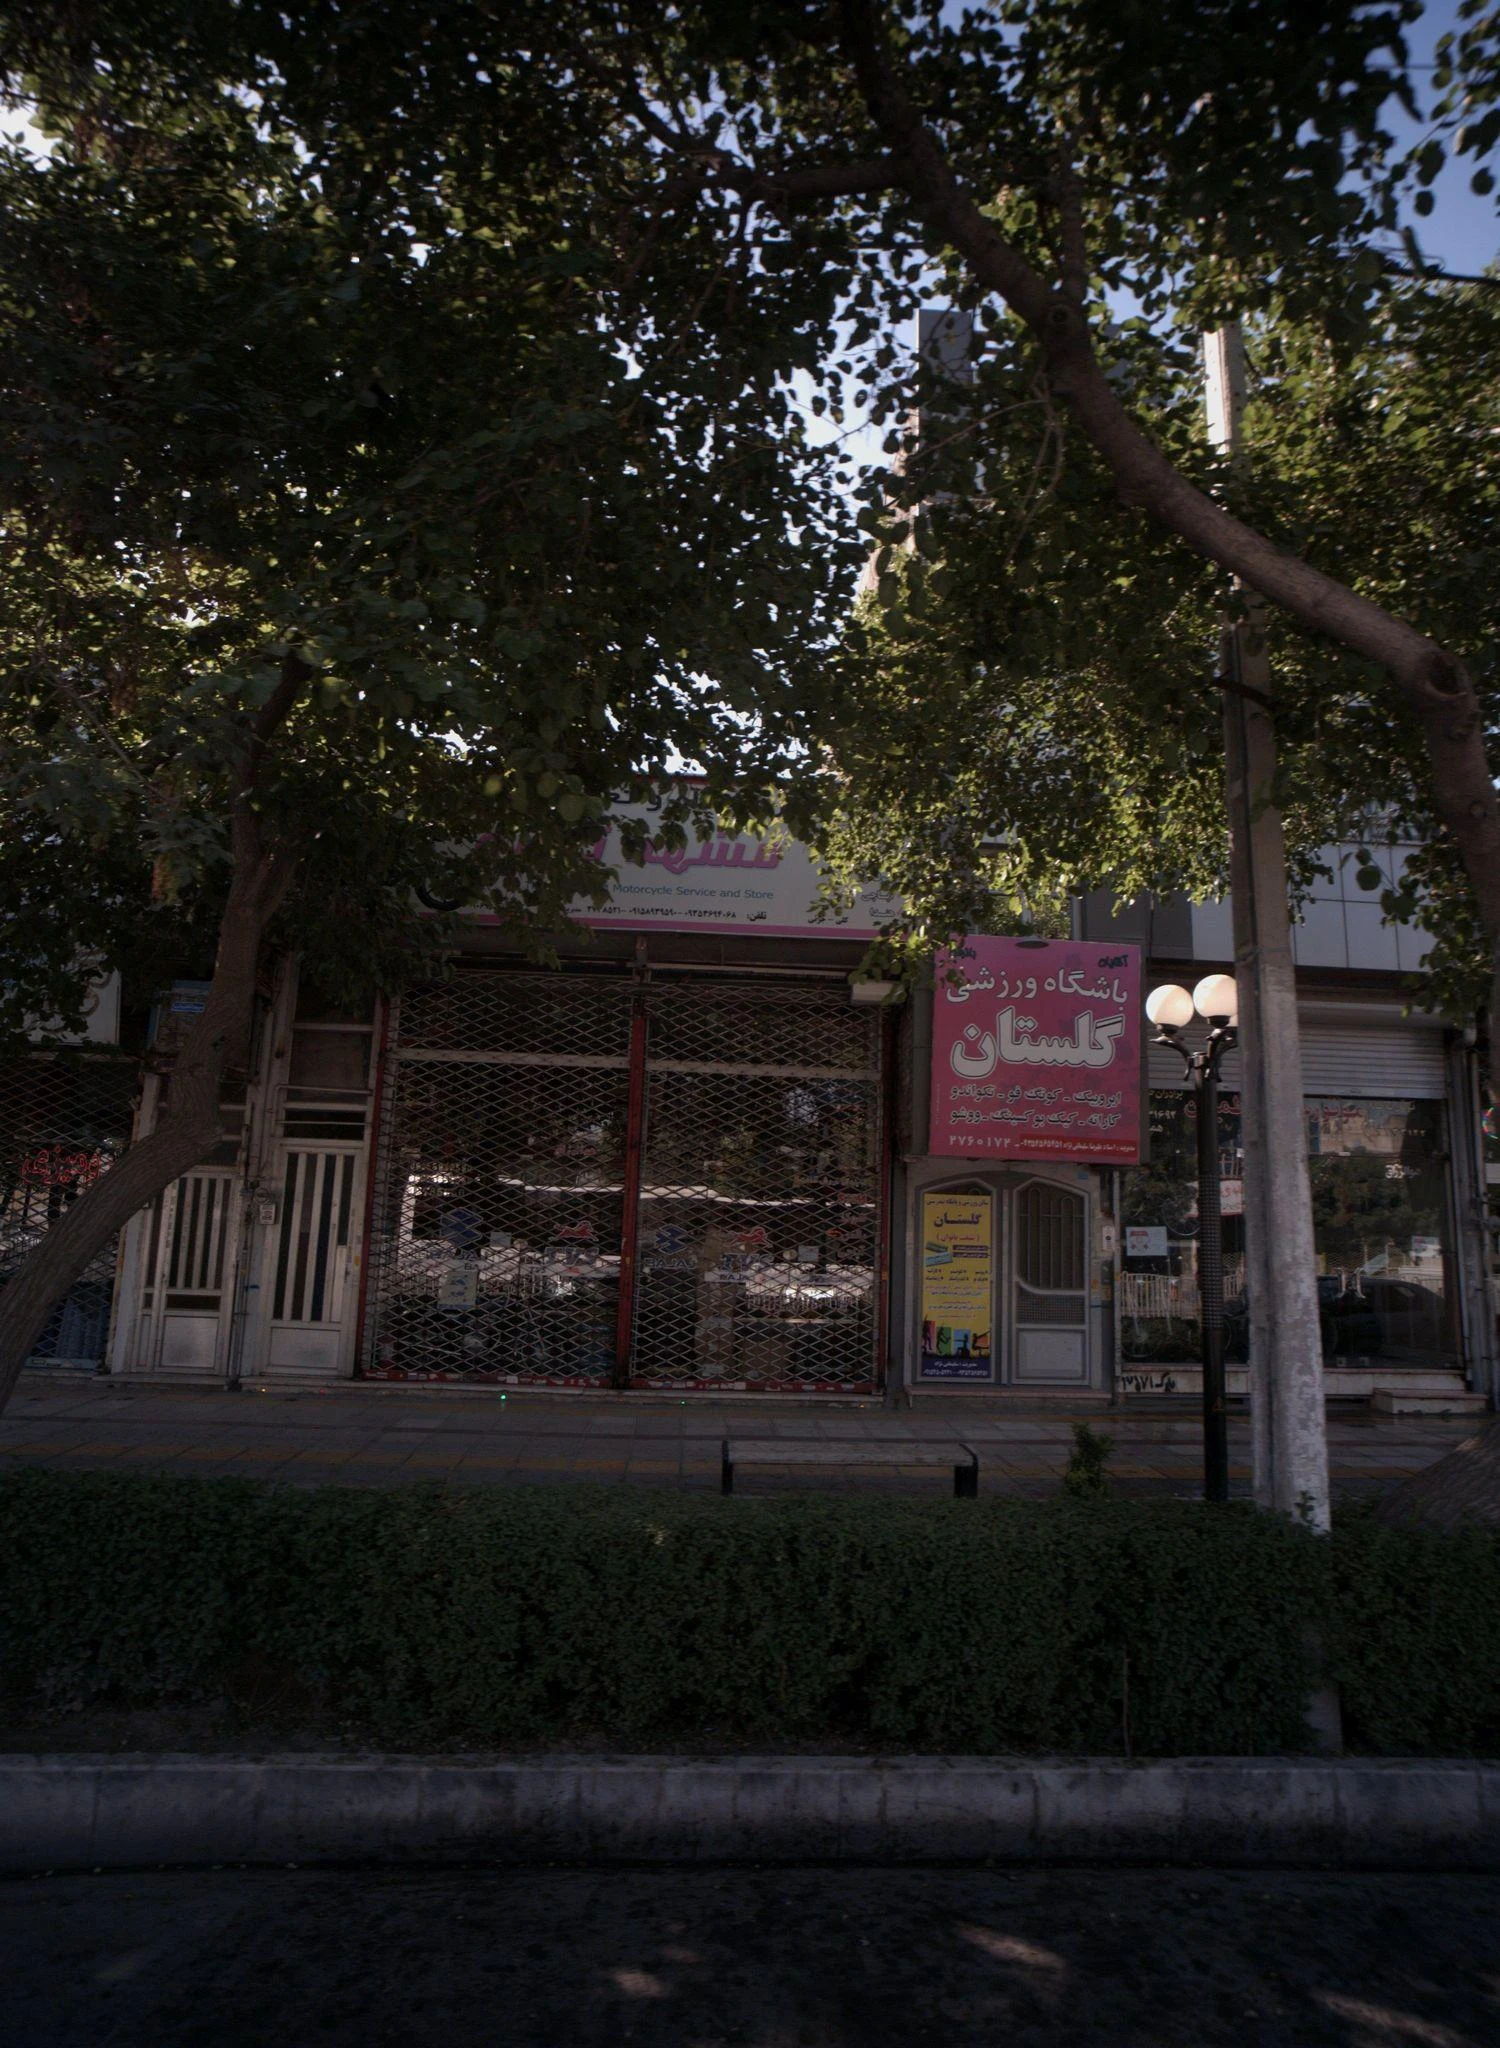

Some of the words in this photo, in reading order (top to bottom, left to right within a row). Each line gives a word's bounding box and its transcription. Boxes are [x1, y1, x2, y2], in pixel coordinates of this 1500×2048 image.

[612, 885, 673, 897] Motorcycle
[676, 886, 717, 898] Service
[719, 887, 741, 899] and
[744, 888, 774, 900] Store
[946, 966, 1038, 1003] ورزشی
[1044, 969, 1129, 1011] باشگاه
[951, 1004, 1126, 1080] گلستان
[950, 1084, 997, 1102] تکواندو
[1087, 1112, 1121, 1129] کاراته
[933, 1211, 983, 1229] گلستان
